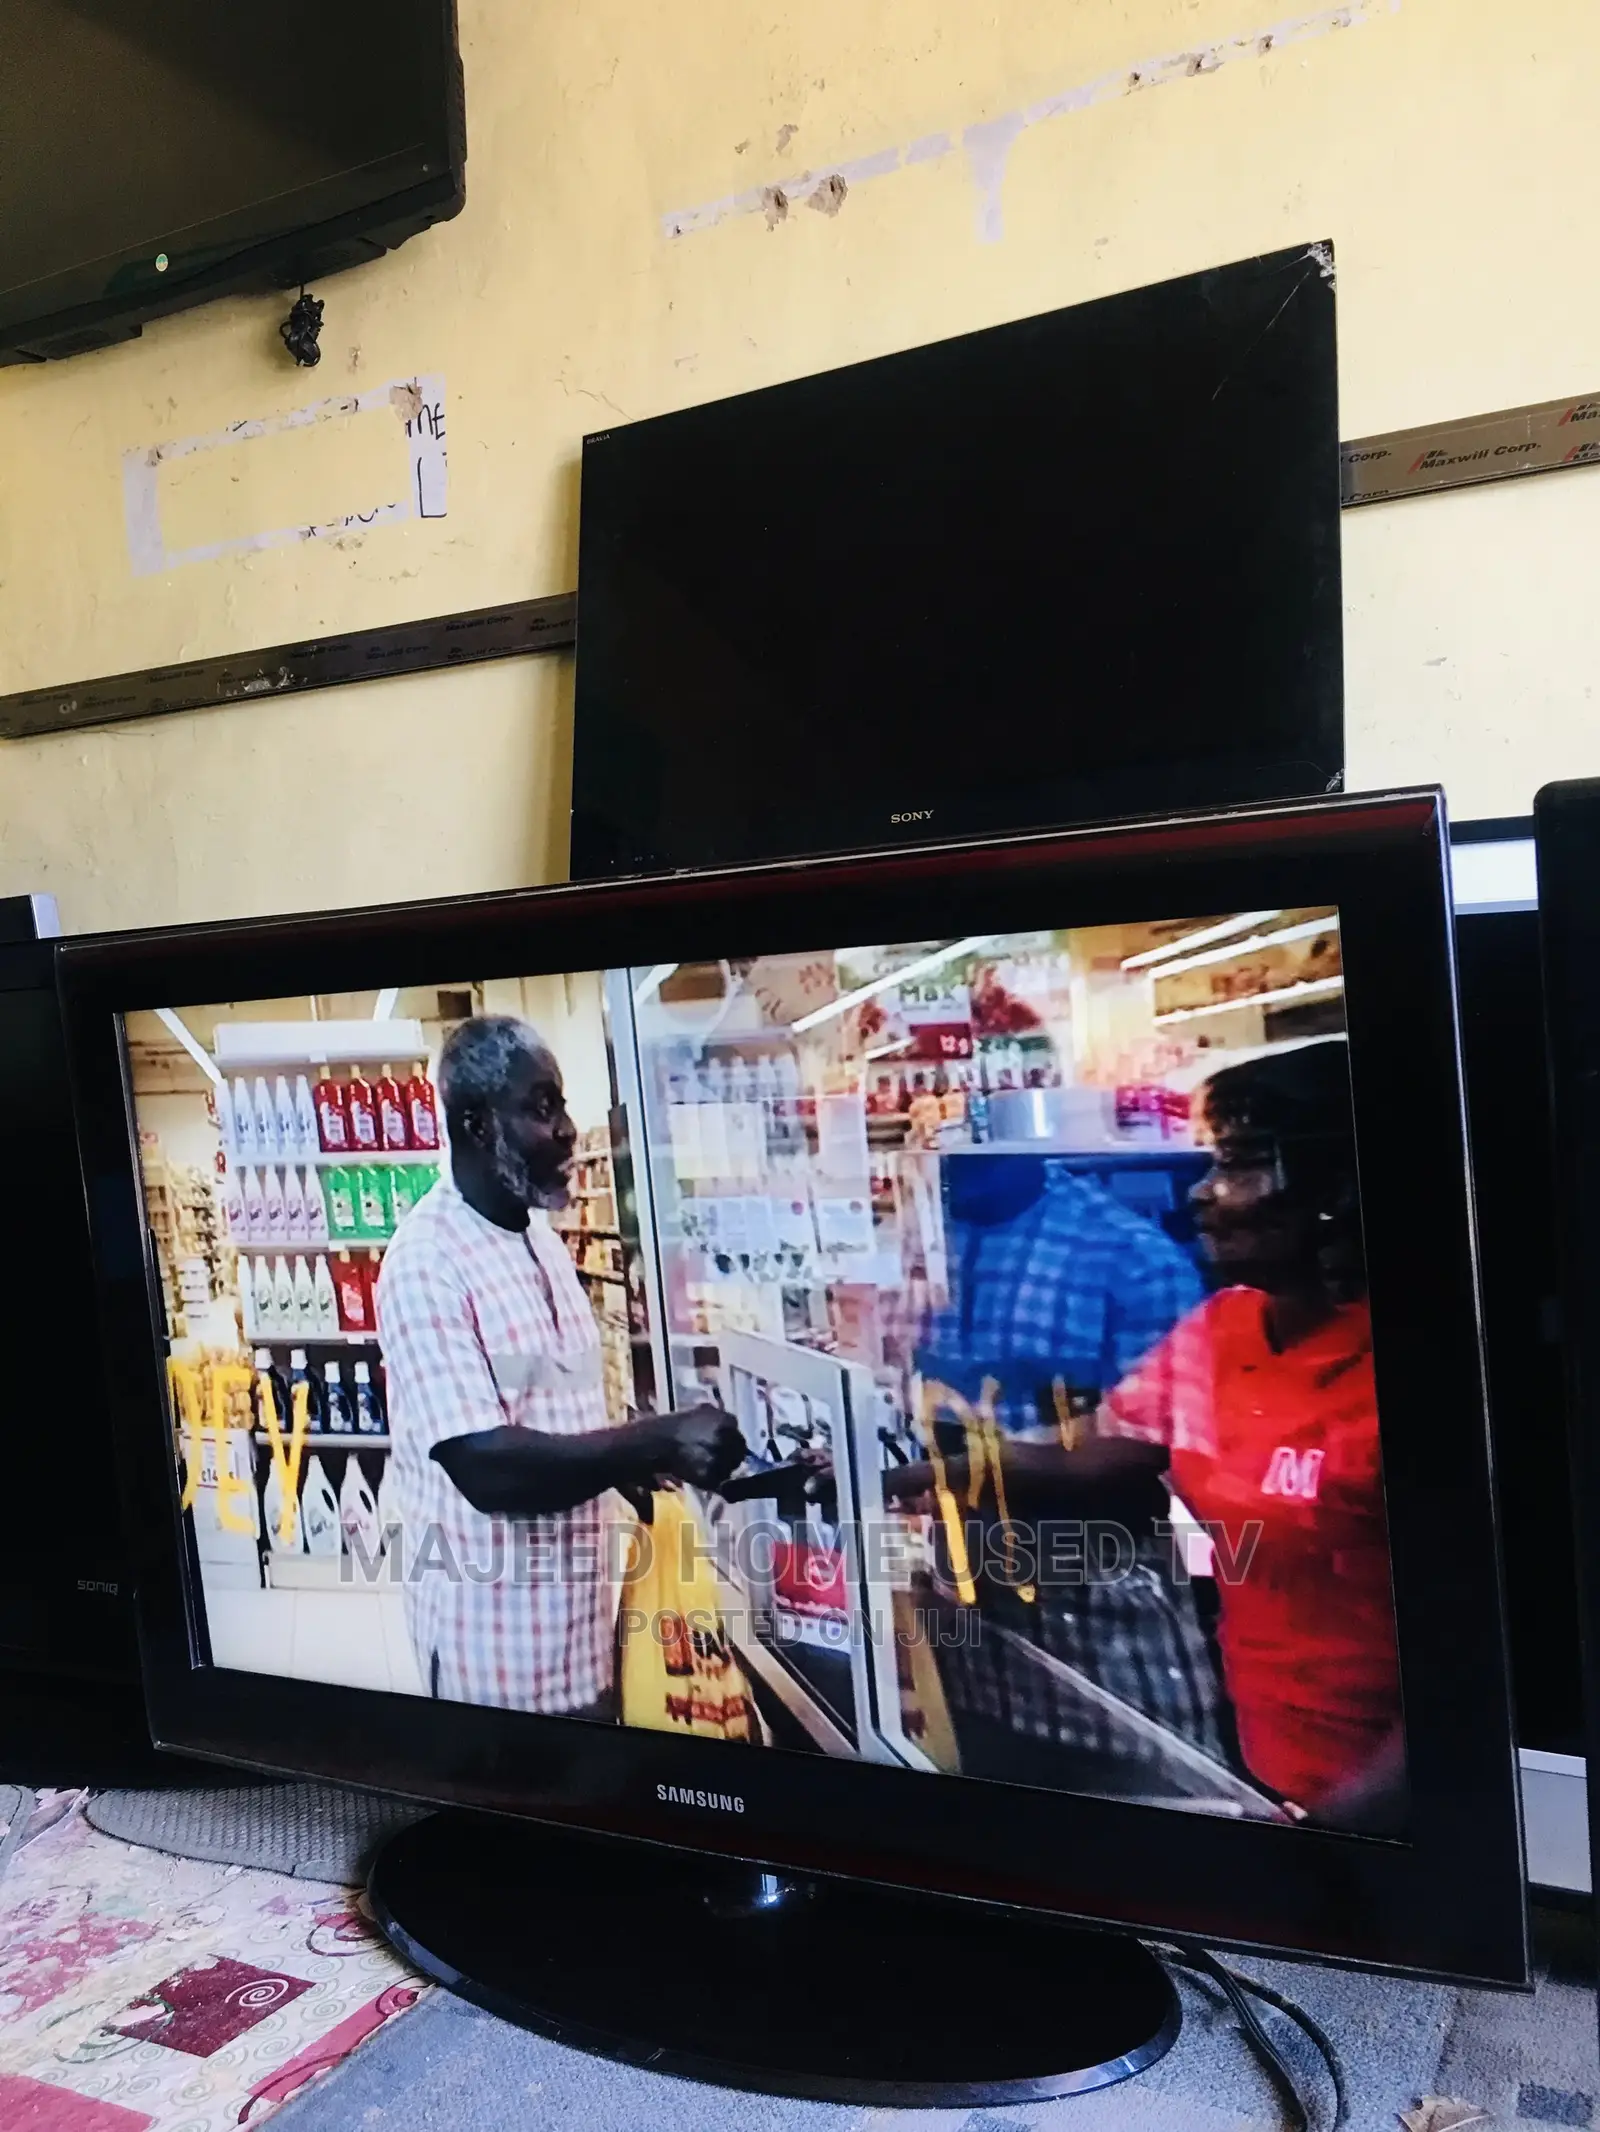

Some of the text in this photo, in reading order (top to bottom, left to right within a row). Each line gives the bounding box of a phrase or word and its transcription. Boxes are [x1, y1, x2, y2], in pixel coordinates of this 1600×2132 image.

[1570, 410, 1600, 423] Ma
[586, 433, 612, 445] BRAVIA
[1348, 450, 1392, 463] Corp.
[1419, 449, 1490, 470] Maxwill
[1493, 442, 1542, 456] Corp.
[890, 809, 934, 824] SONY
[656, 1783, 745, 1813] SAMSUNG
